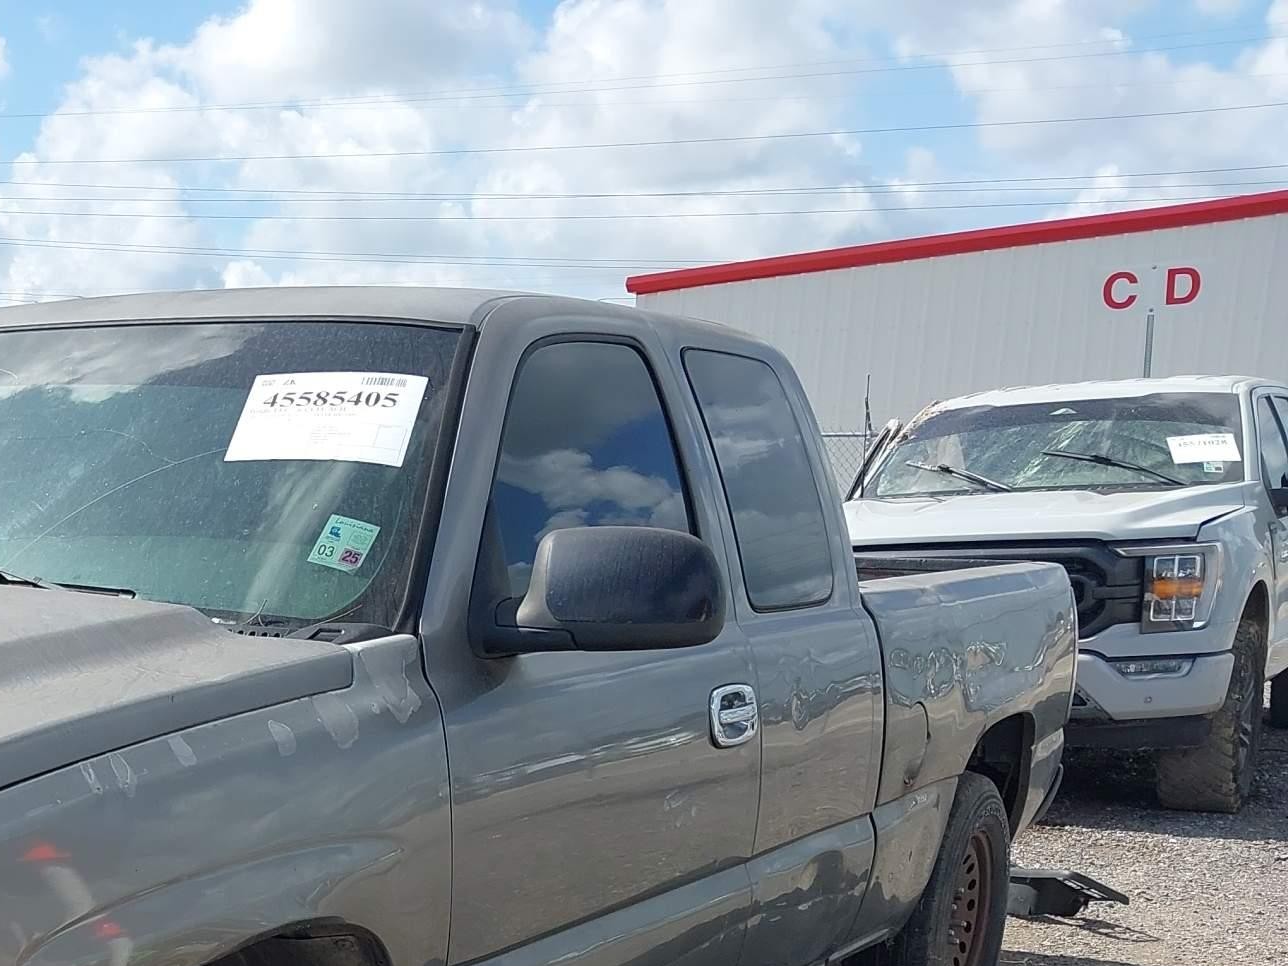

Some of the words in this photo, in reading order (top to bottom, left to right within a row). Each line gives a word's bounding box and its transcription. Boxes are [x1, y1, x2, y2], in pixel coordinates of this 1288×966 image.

[1102, 271, 1139, 310] C
[1165, 267, 1202, 306] D
[263, 390, 400, 408] 45585405
[317, 544, 335, 558] 03
[341, 550, 361, 564] 25
